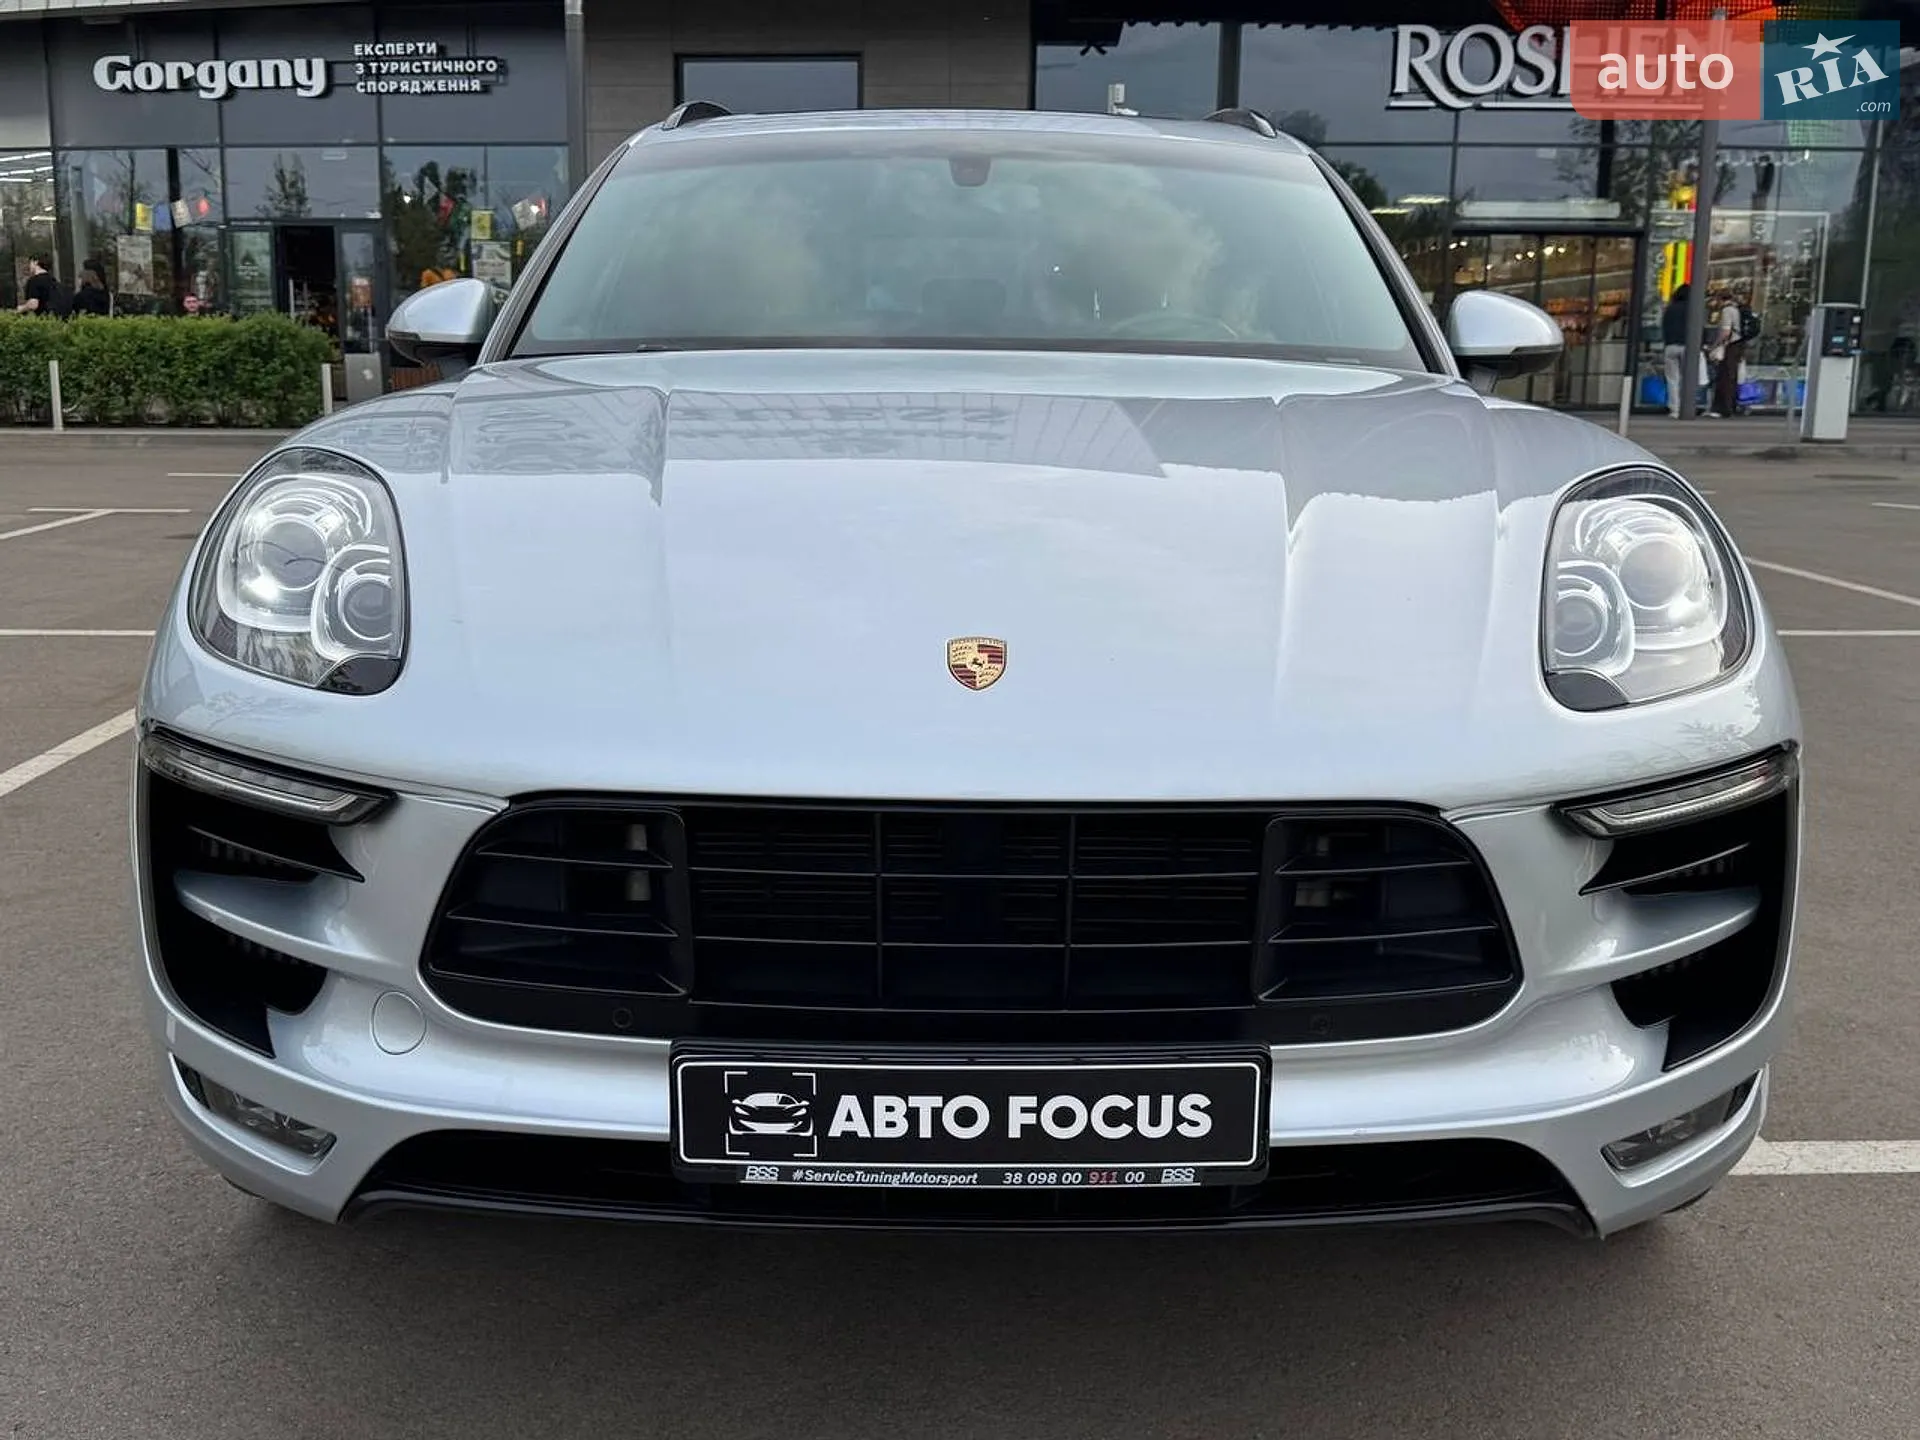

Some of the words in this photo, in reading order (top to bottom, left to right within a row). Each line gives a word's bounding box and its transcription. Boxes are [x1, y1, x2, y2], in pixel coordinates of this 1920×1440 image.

[353, 42, 437, 56] ЕКСПЕРТИ
[368, 59, 498, 74] ТУРИСТИЧНОГО
[93, 55, 326, 100] Gorgany
[356, 79, 481, 94] СПОРЯДЖЕННЯ
[1007, 1093, 1213, 1140] FOCUS
[745, 1166, 780, 1181] BSS
[792, 1169, 978, 1187] #ServiceTuningMotorsport
[1002, 1172, 1023, 1185] 38
[1027, 1172, 1058, 1185] 098
[1062, 1172, 1083, 1185] 00
[1088, 1171, 1118, 1185] 911
[1125, 1171, 1146, 1184] 00
[1161, 1168, 1196, 1184] BSS
